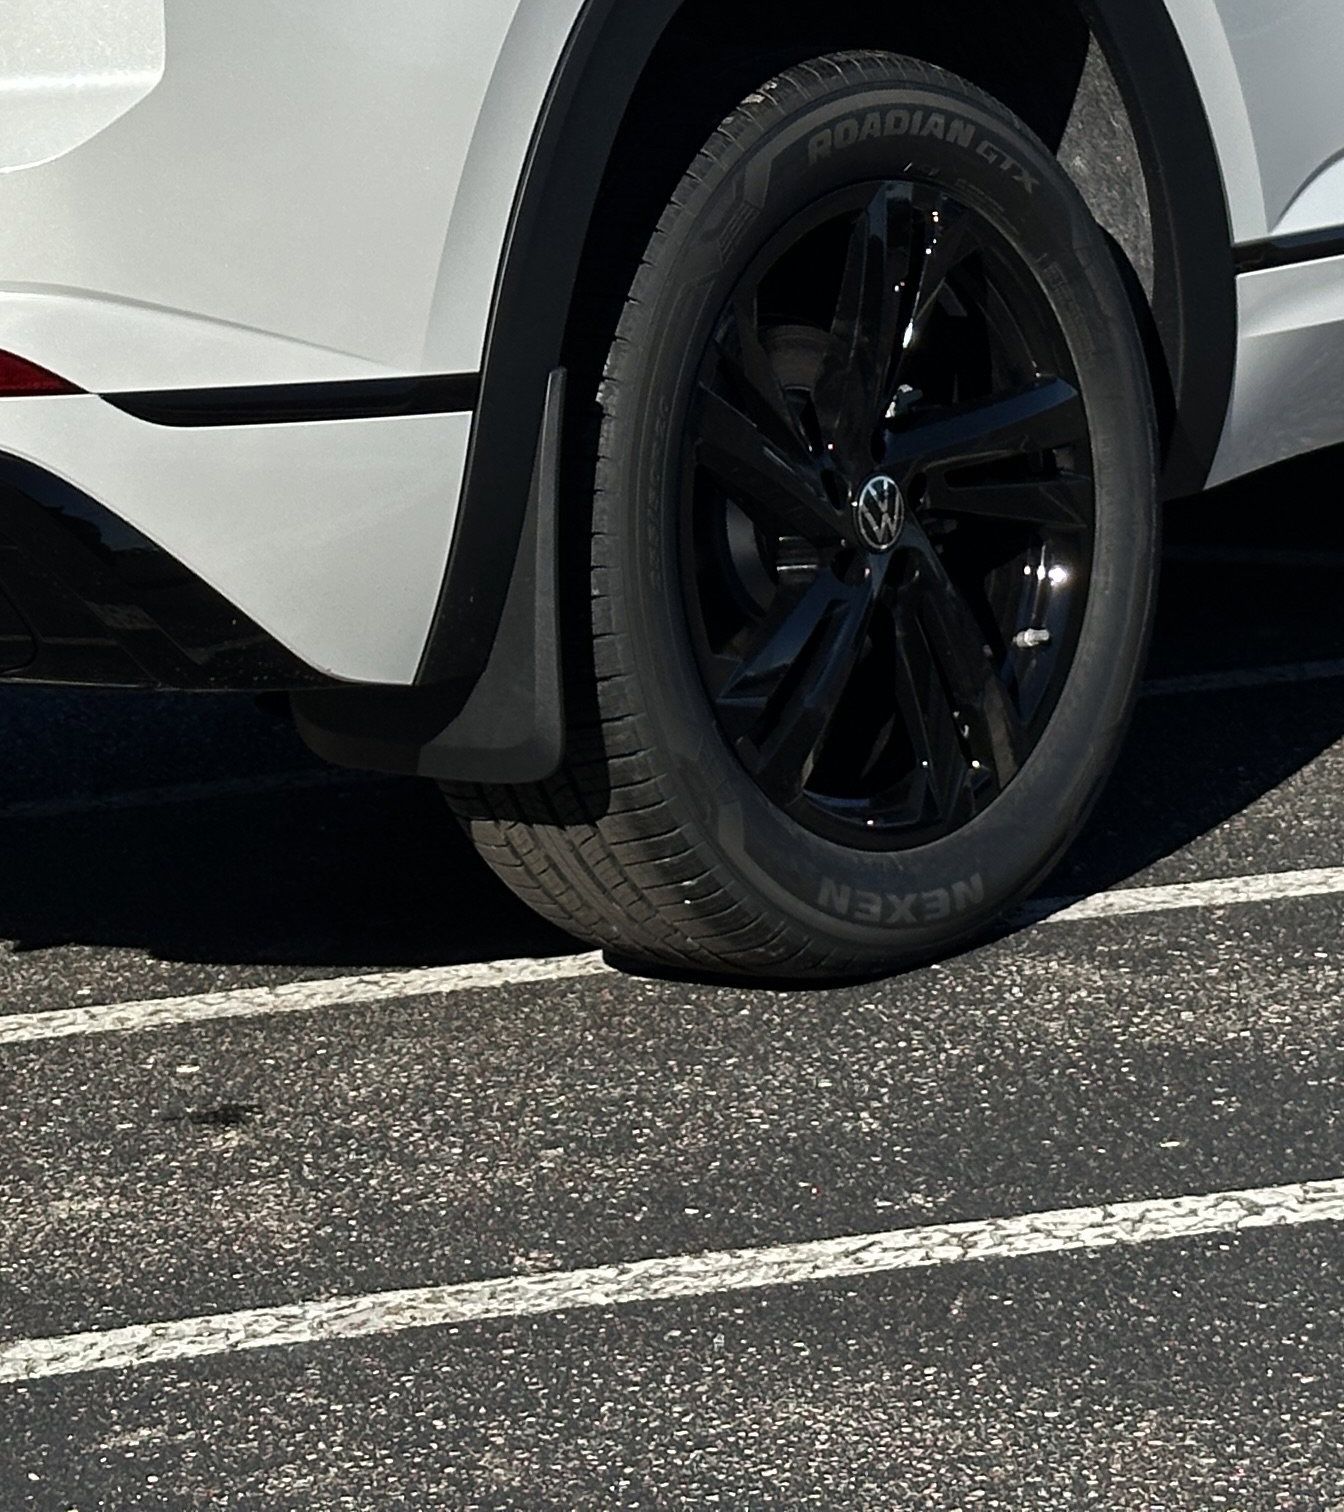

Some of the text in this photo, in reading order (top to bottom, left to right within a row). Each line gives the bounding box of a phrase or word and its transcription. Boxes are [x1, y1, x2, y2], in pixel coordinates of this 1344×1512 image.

[807, 108, 1040, 194] ROADIAN GTX
[816, 872, 986, 924] NEXEN
